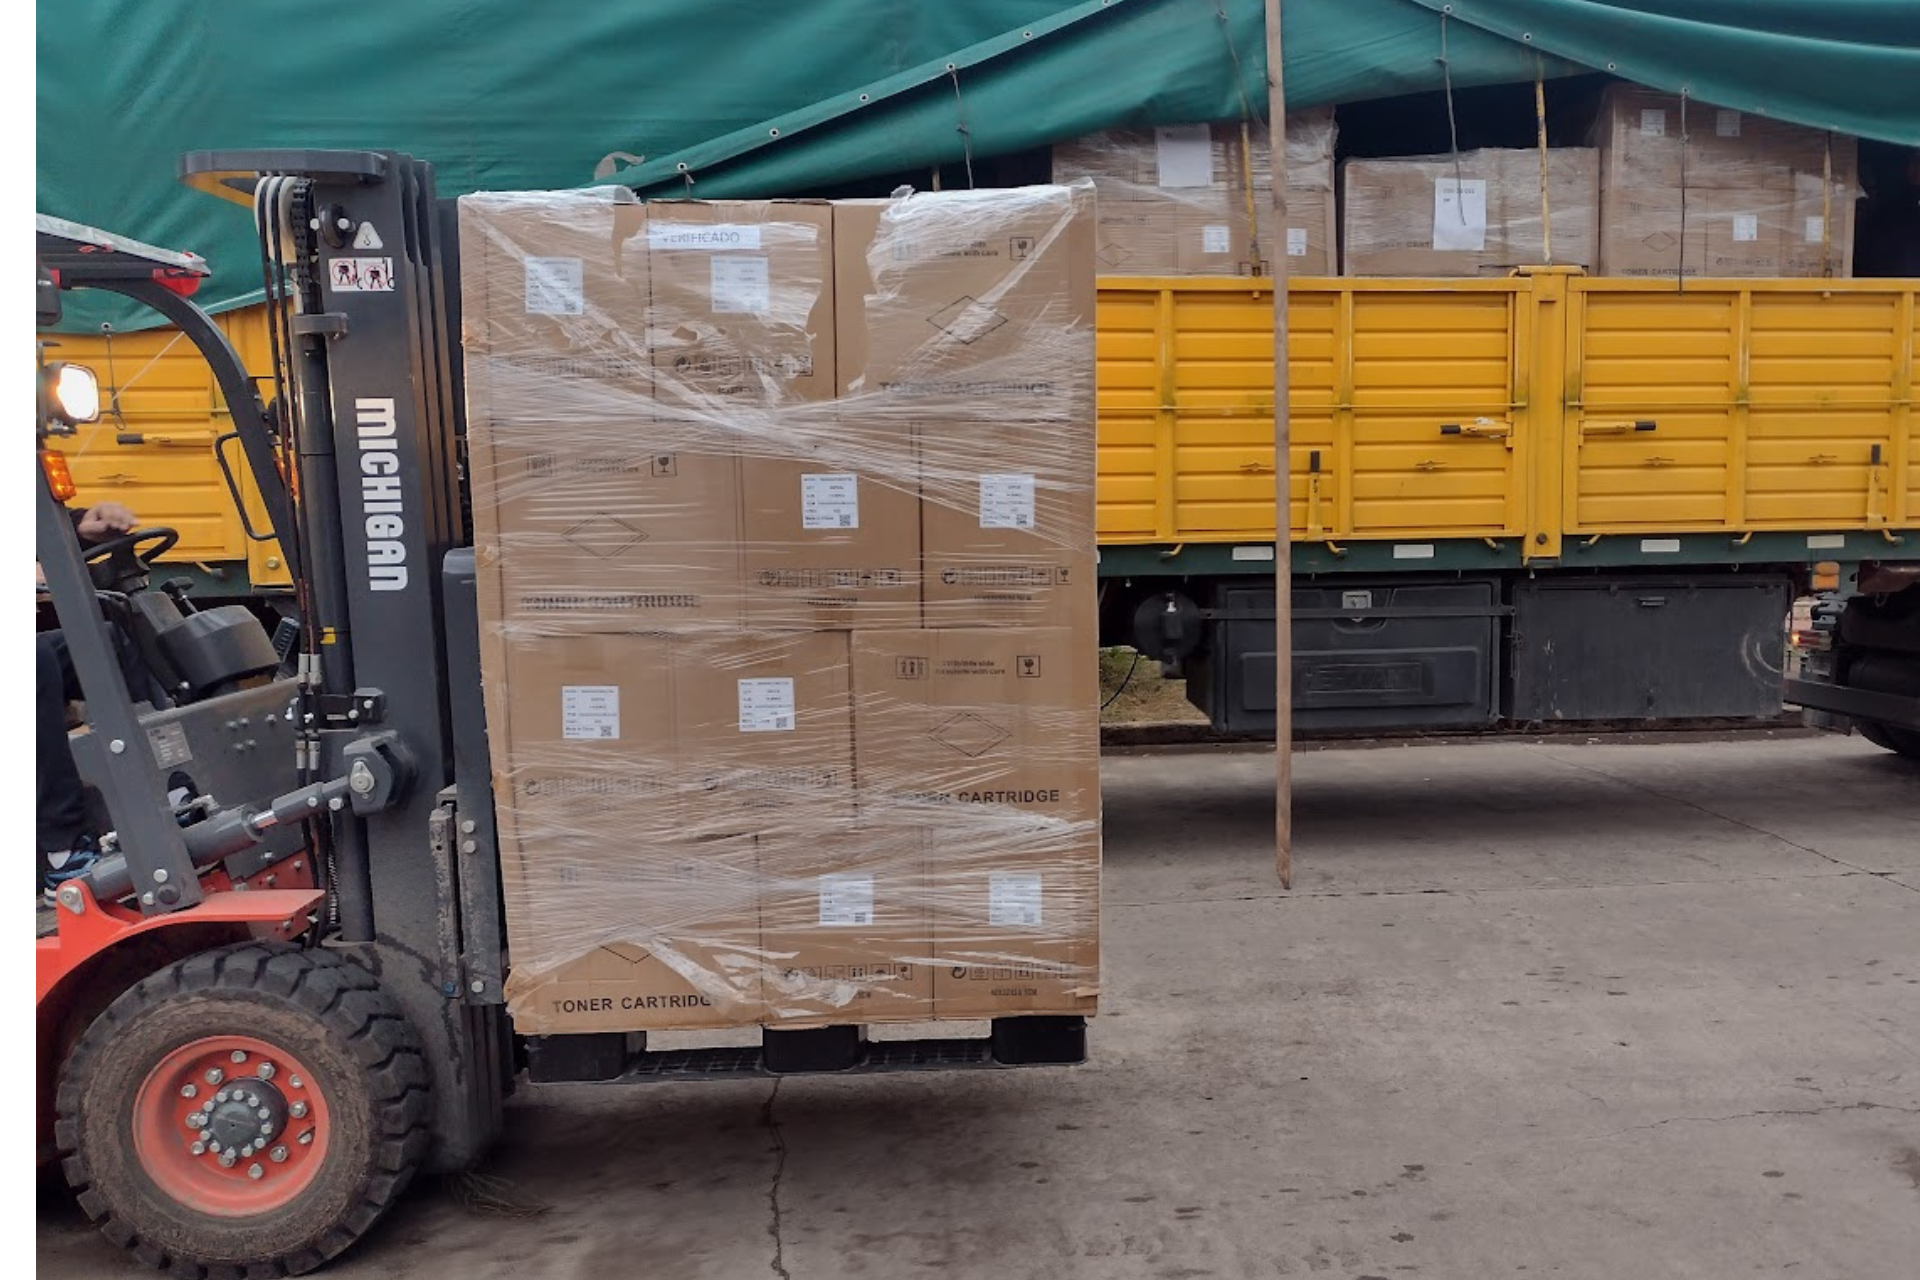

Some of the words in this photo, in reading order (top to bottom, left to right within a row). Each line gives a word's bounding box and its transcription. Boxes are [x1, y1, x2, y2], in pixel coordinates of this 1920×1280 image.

[1650, 267, 1697, 276] CARTRDGE
[354, 397, 409, 592] MICHIGAN
[958, 789, 1060, 804] CARTRIDGE
[552, 997, 613, 1014] TONER
[620, 994, 712, 1011] CARTRIDG
